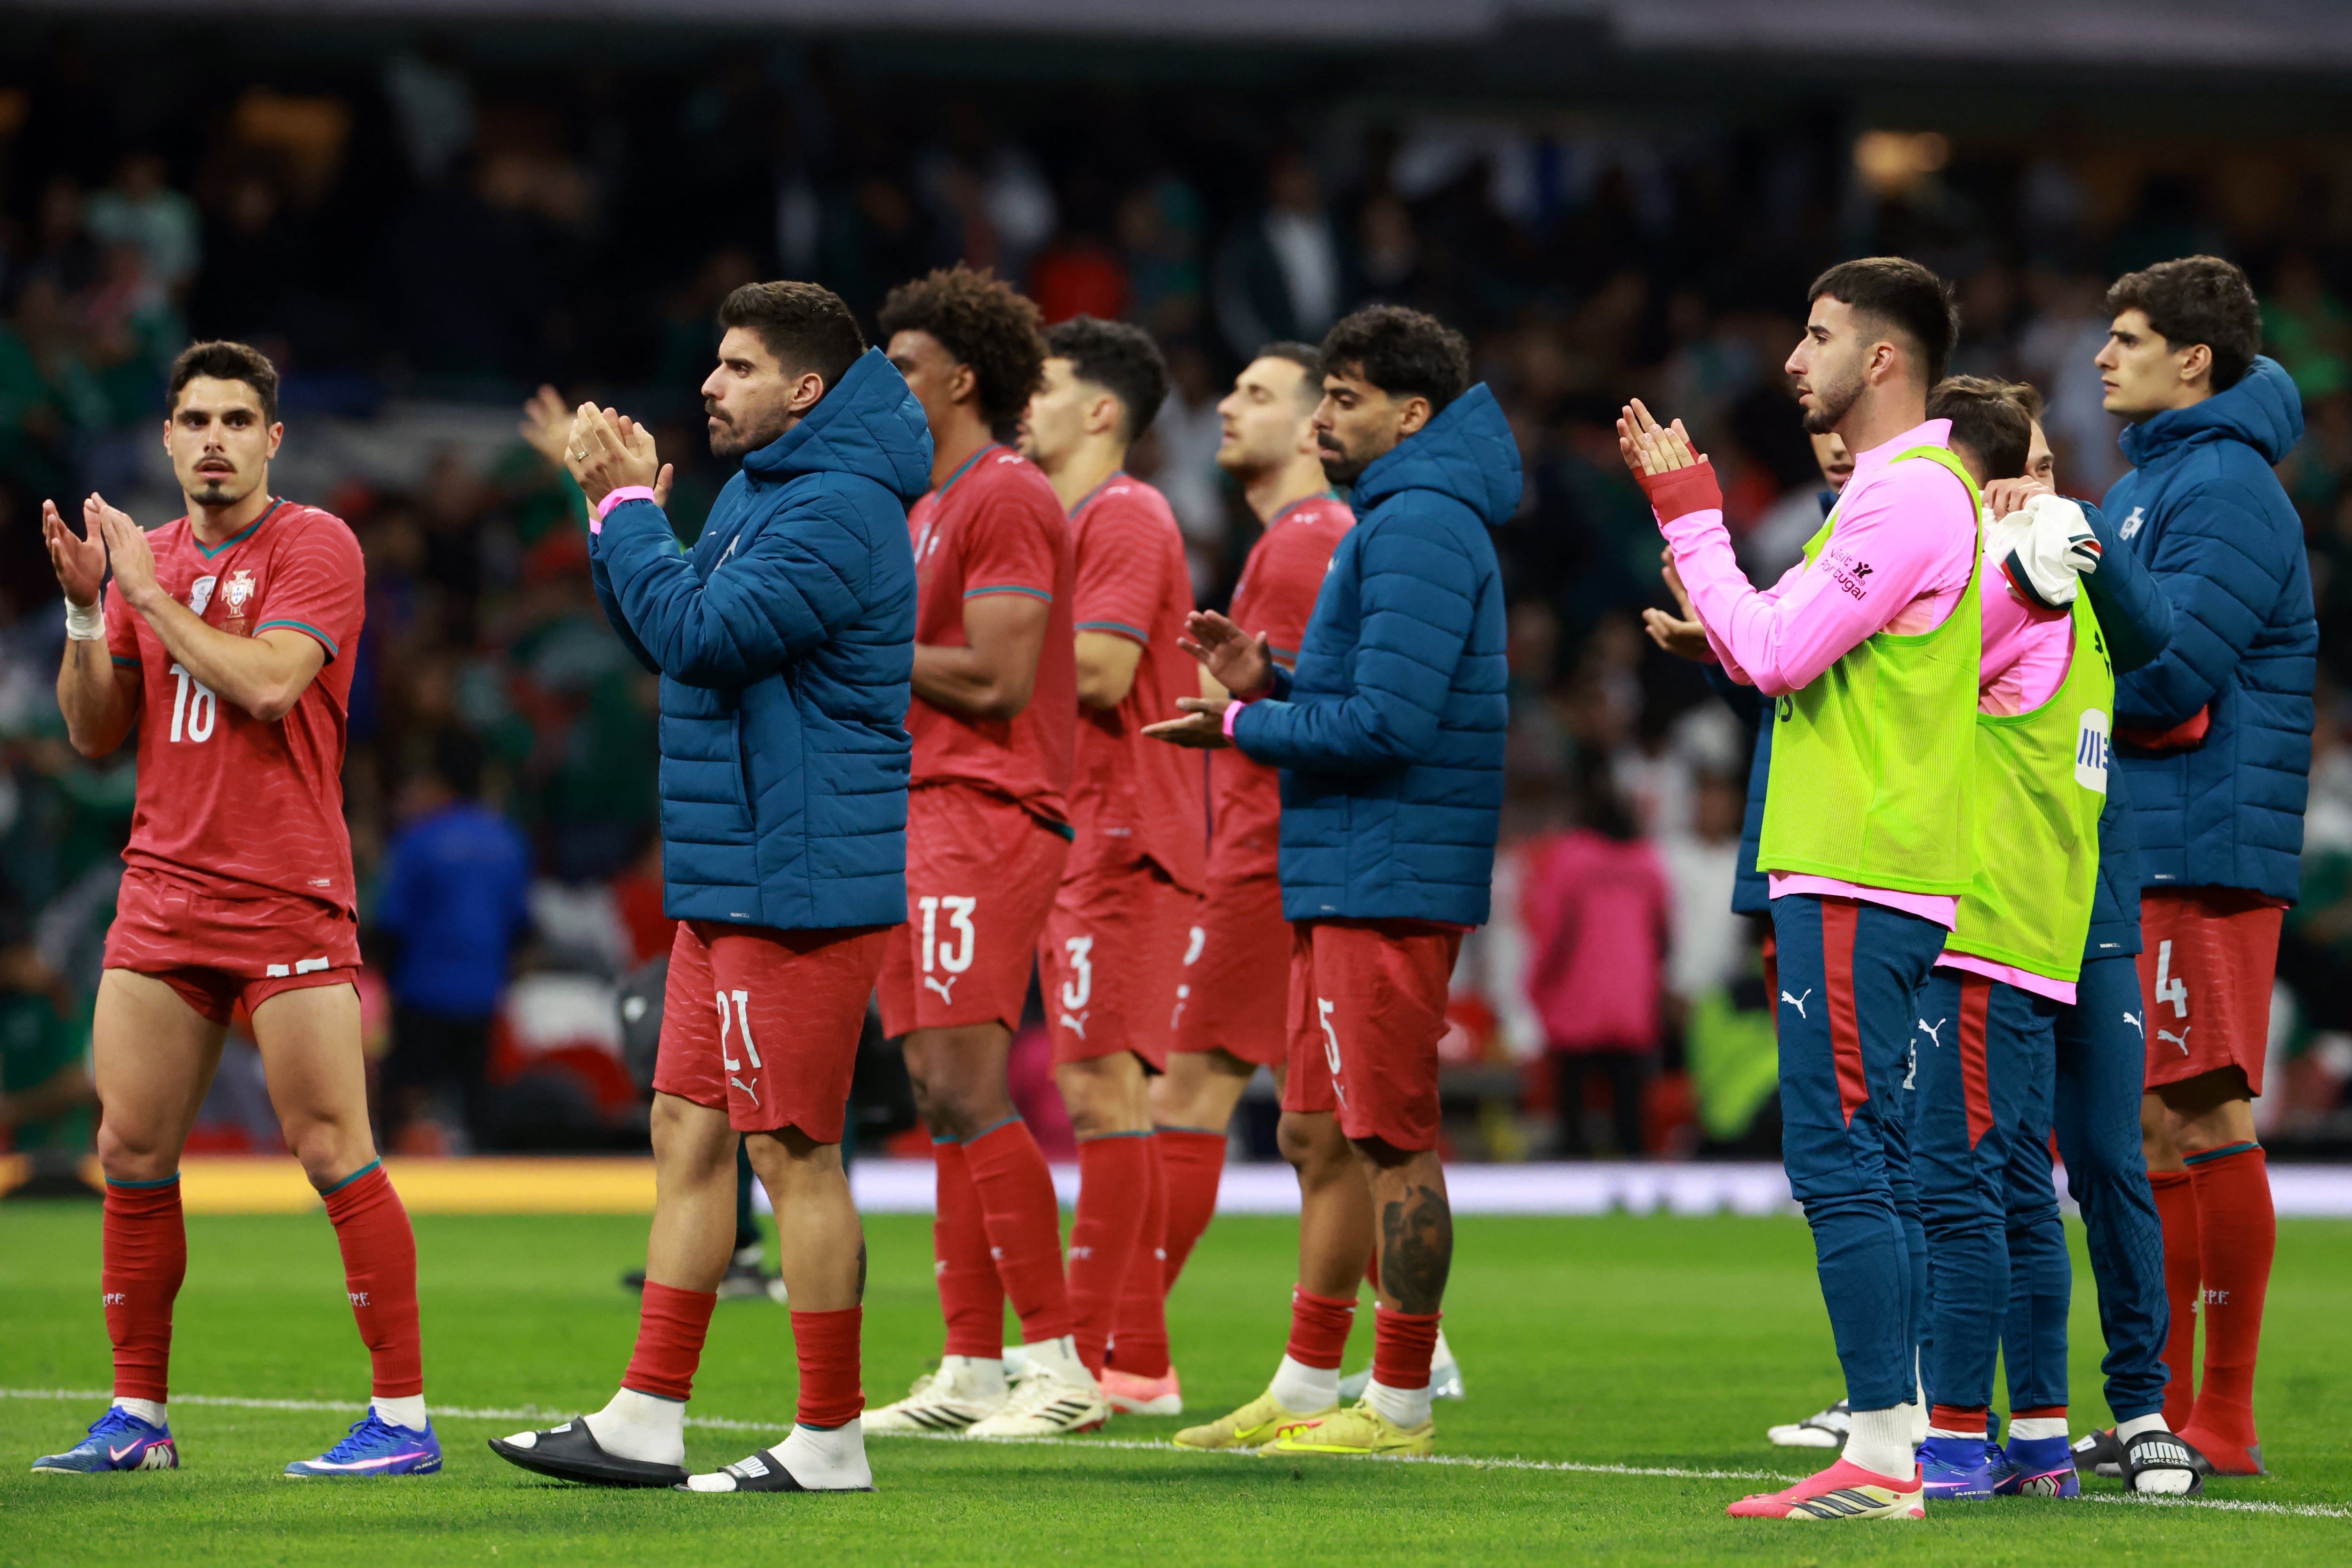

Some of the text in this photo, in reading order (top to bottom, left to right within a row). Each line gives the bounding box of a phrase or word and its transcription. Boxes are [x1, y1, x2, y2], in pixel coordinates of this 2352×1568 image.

[1818, 559, 1867, 601] Portugal
[1831, 549, 1852, 566] visit
[169, 663, 216, 743] 18
[919, 896, 976, 973] 13
[1062, 935, 1093, 1010] 3
[2155, 939, 2188, 1018] 4
[717, 990, 762, 1071] 21
[1317, 997, 1341, 1075] 5
[2130, 1442, 2190, 1465] PUMA
